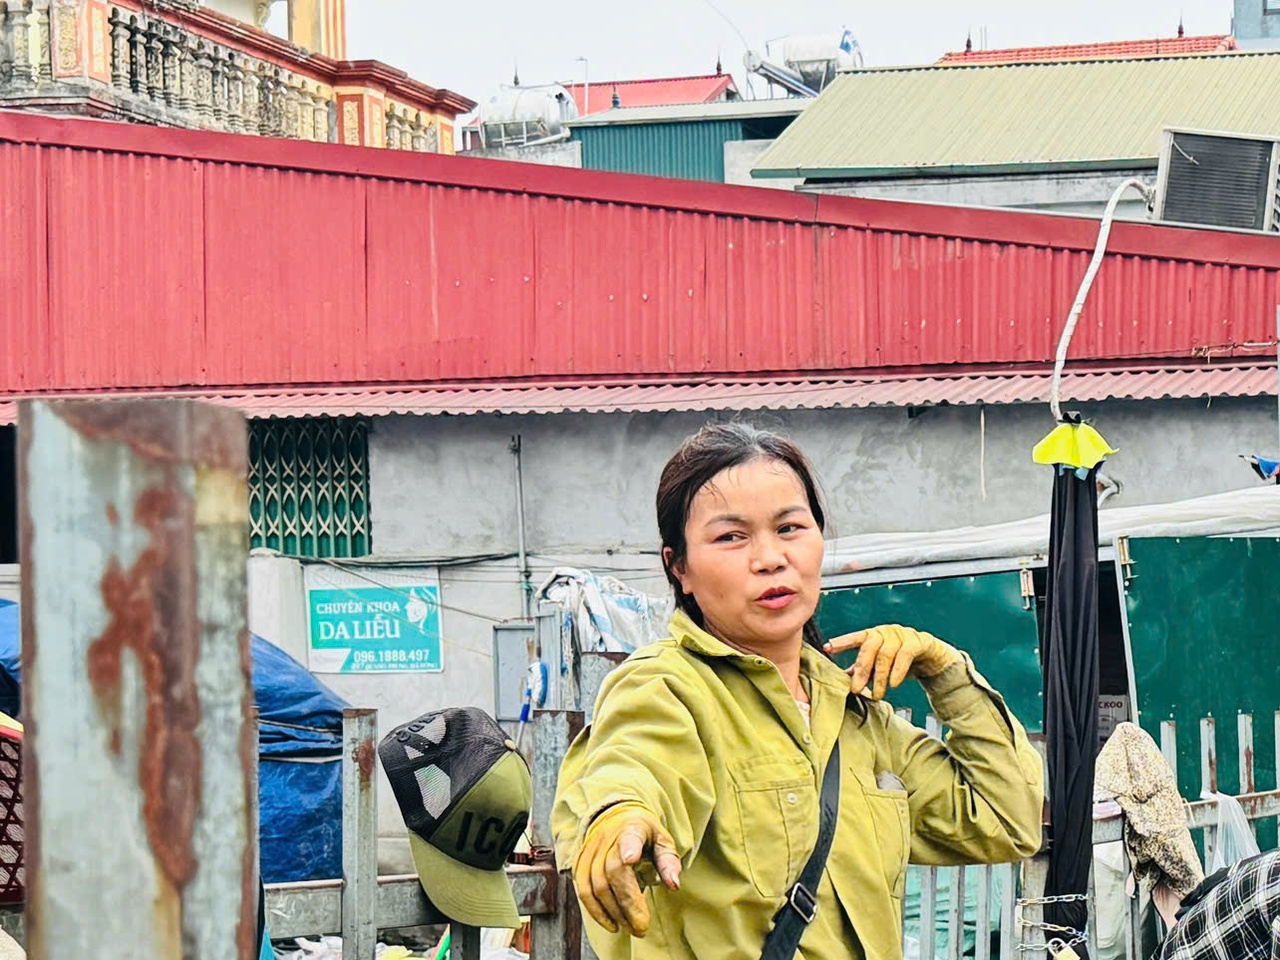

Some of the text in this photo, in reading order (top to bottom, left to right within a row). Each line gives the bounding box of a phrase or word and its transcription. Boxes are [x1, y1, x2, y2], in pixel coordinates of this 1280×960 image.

[316, 600, 400, 613] CHUYÊN KHOA
[319, 622, 350, 639] DA
[354, 649, 429, 662] 096.1888.497
